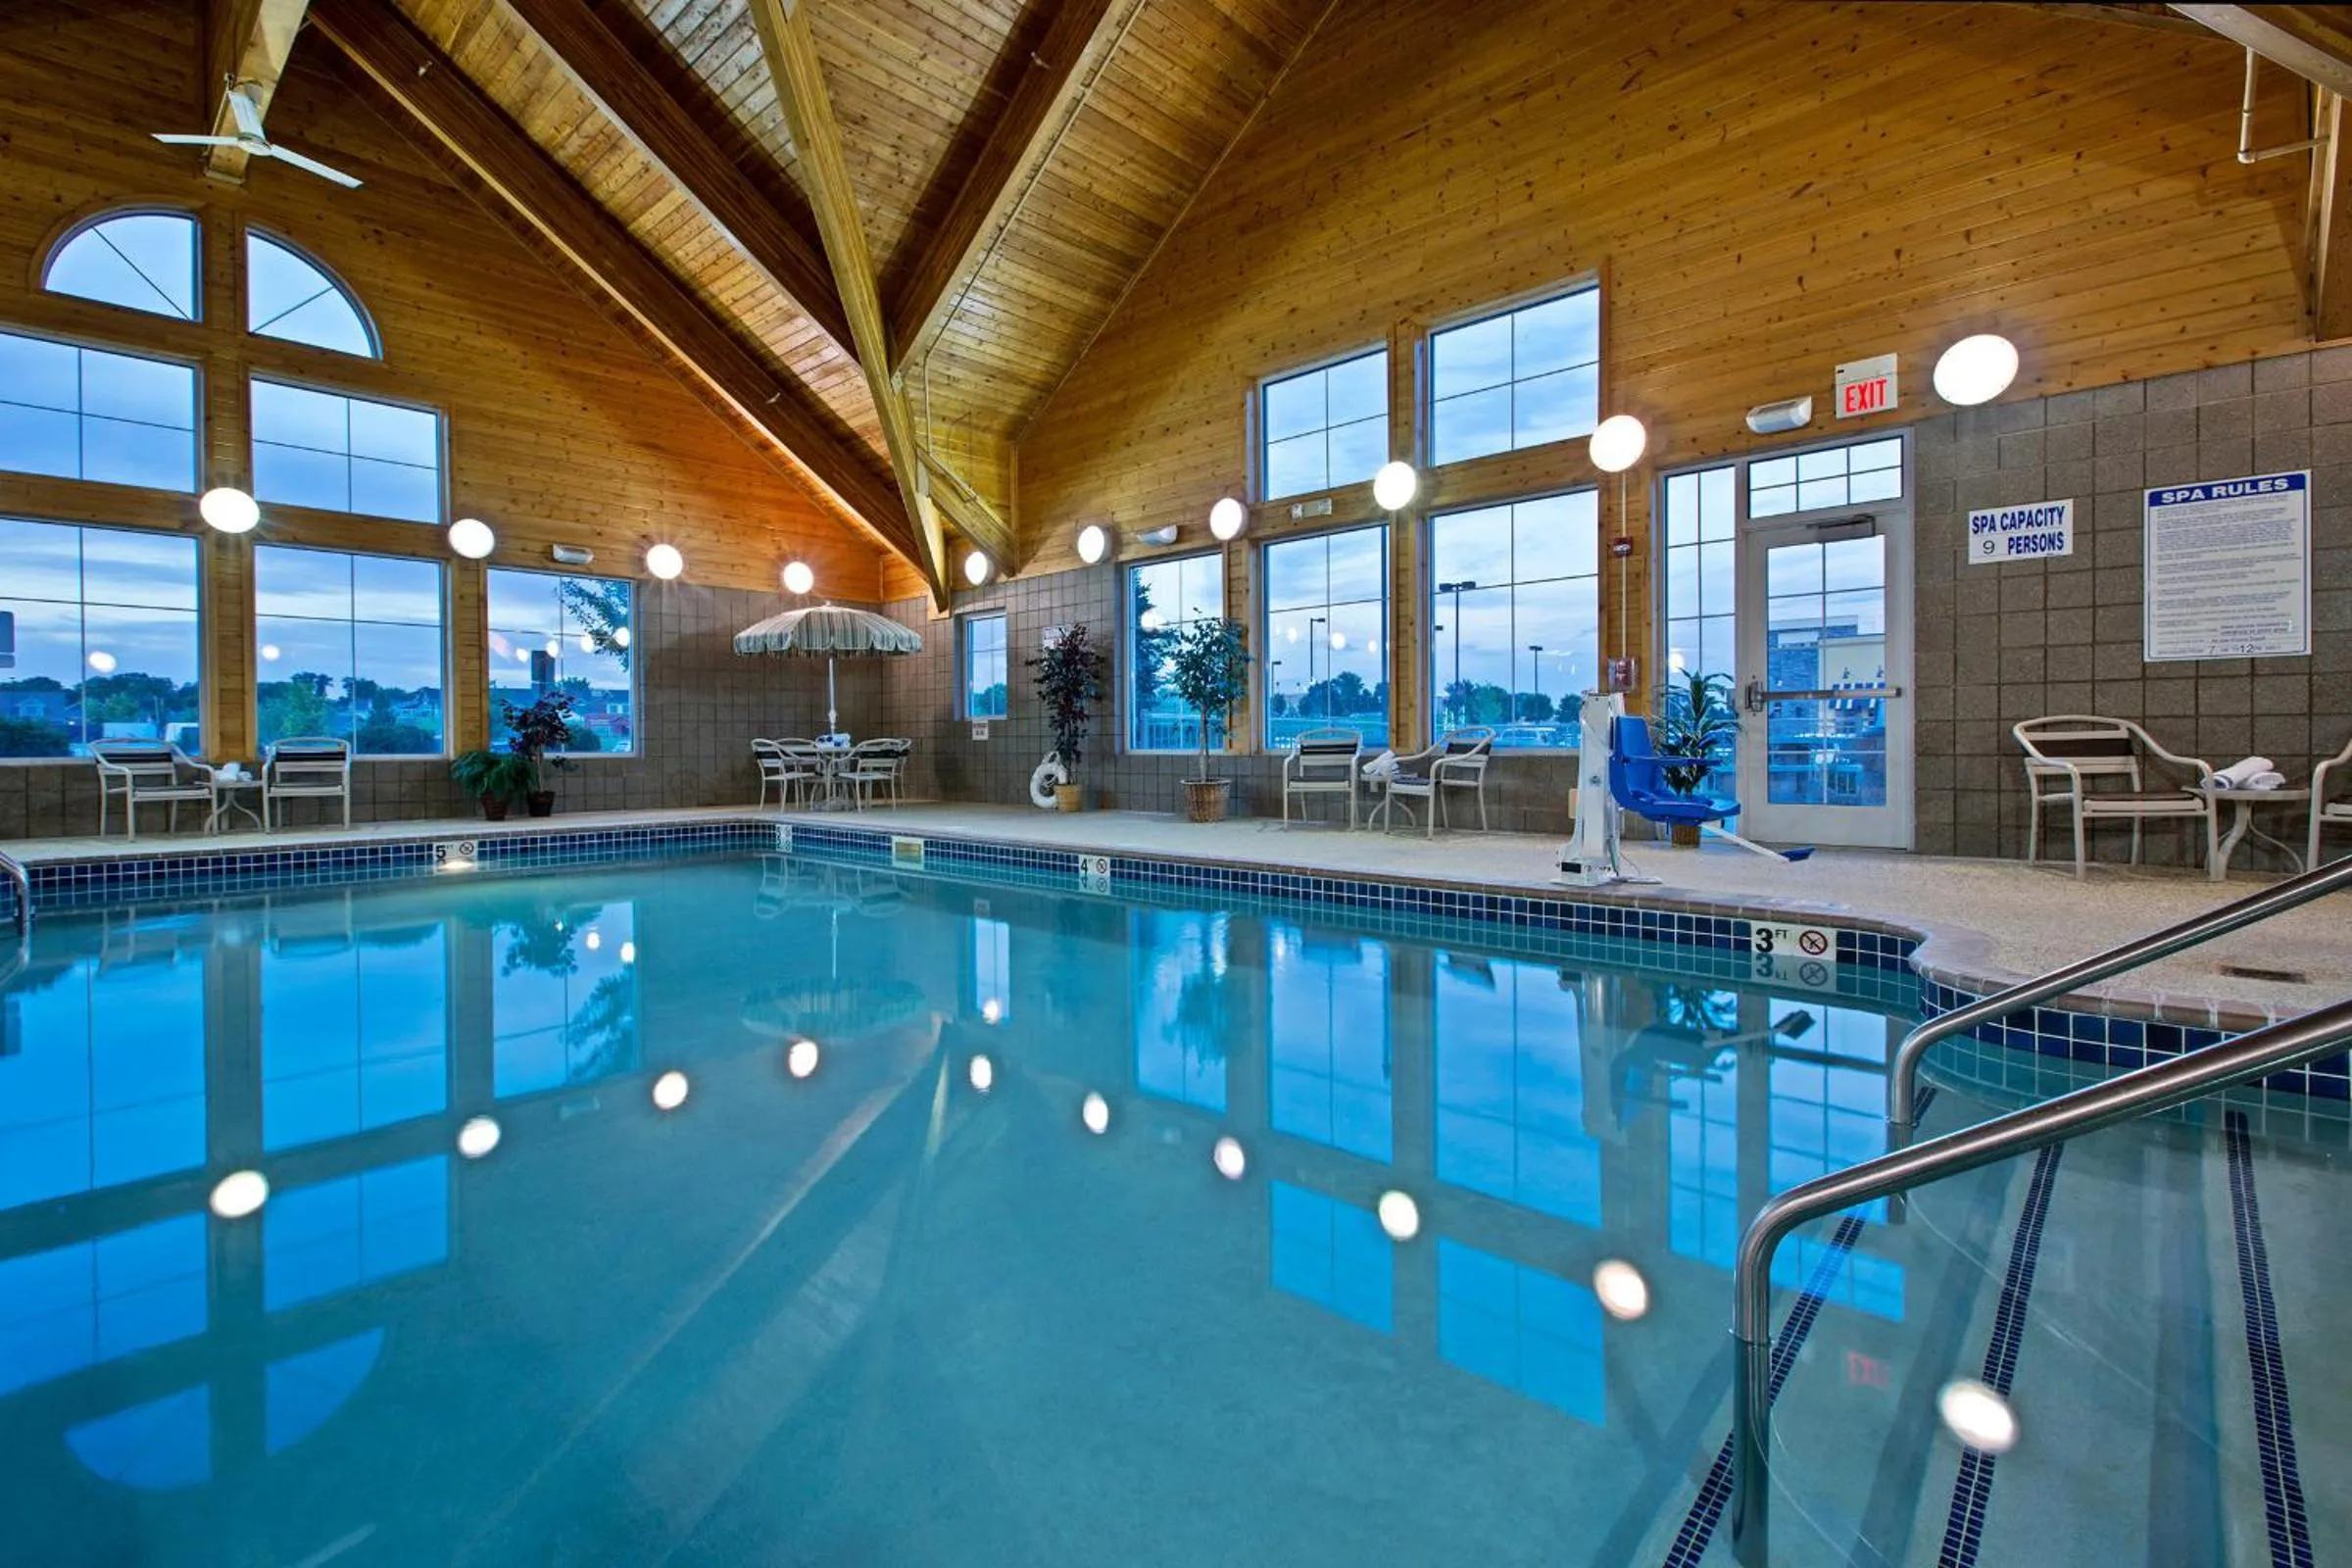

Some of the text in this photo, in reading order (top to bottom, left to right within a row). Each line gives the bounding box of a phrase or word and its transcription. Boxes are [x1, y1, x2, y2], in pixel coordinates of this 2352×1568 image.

[1846, 379, 1886, 413] EXIT
[2161, 477, 2290, 504] SPA RULES
[1972, 506, 2065, 534] SPA CAPACITY
[1983, 531, 2065, 556] 9 PERSONS
[435, 844, 447, 859] 5
[1081, 858, 1089, 875] 4
[1755, 927, 1774, 954] 3
